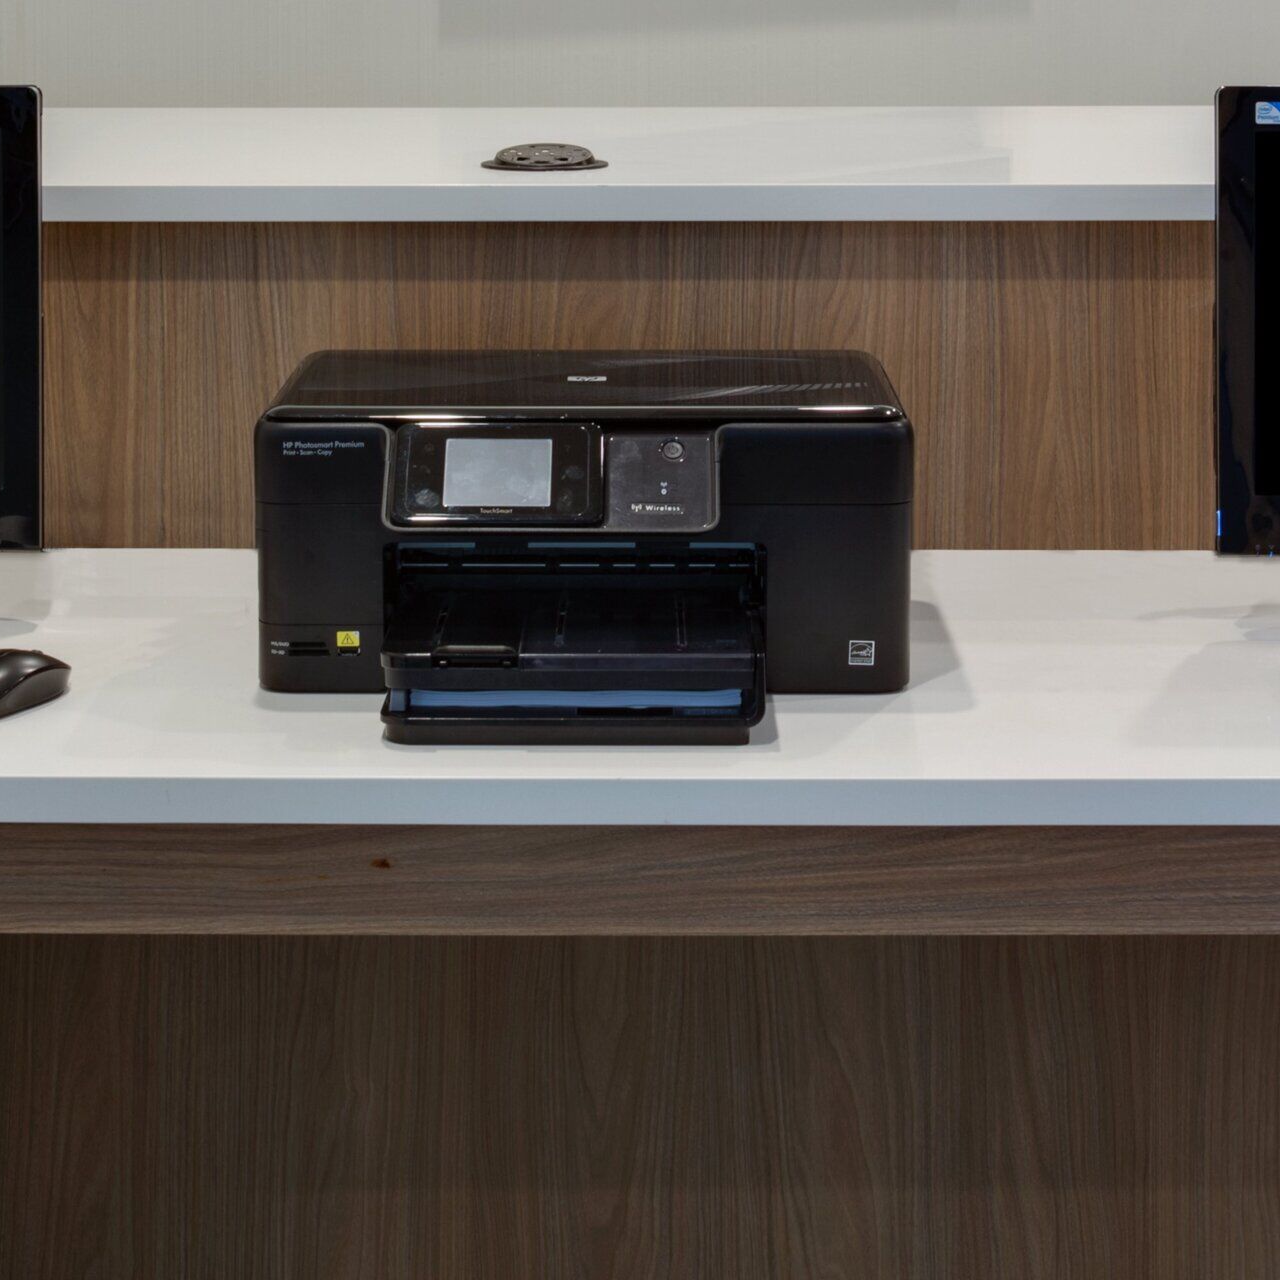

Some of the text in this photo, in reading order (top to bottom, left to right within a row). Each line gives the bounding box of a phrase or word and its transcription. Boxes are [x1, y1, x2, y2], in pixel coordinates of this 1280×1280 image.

[282, 440, 365, 449] HP Photosmart Premium
